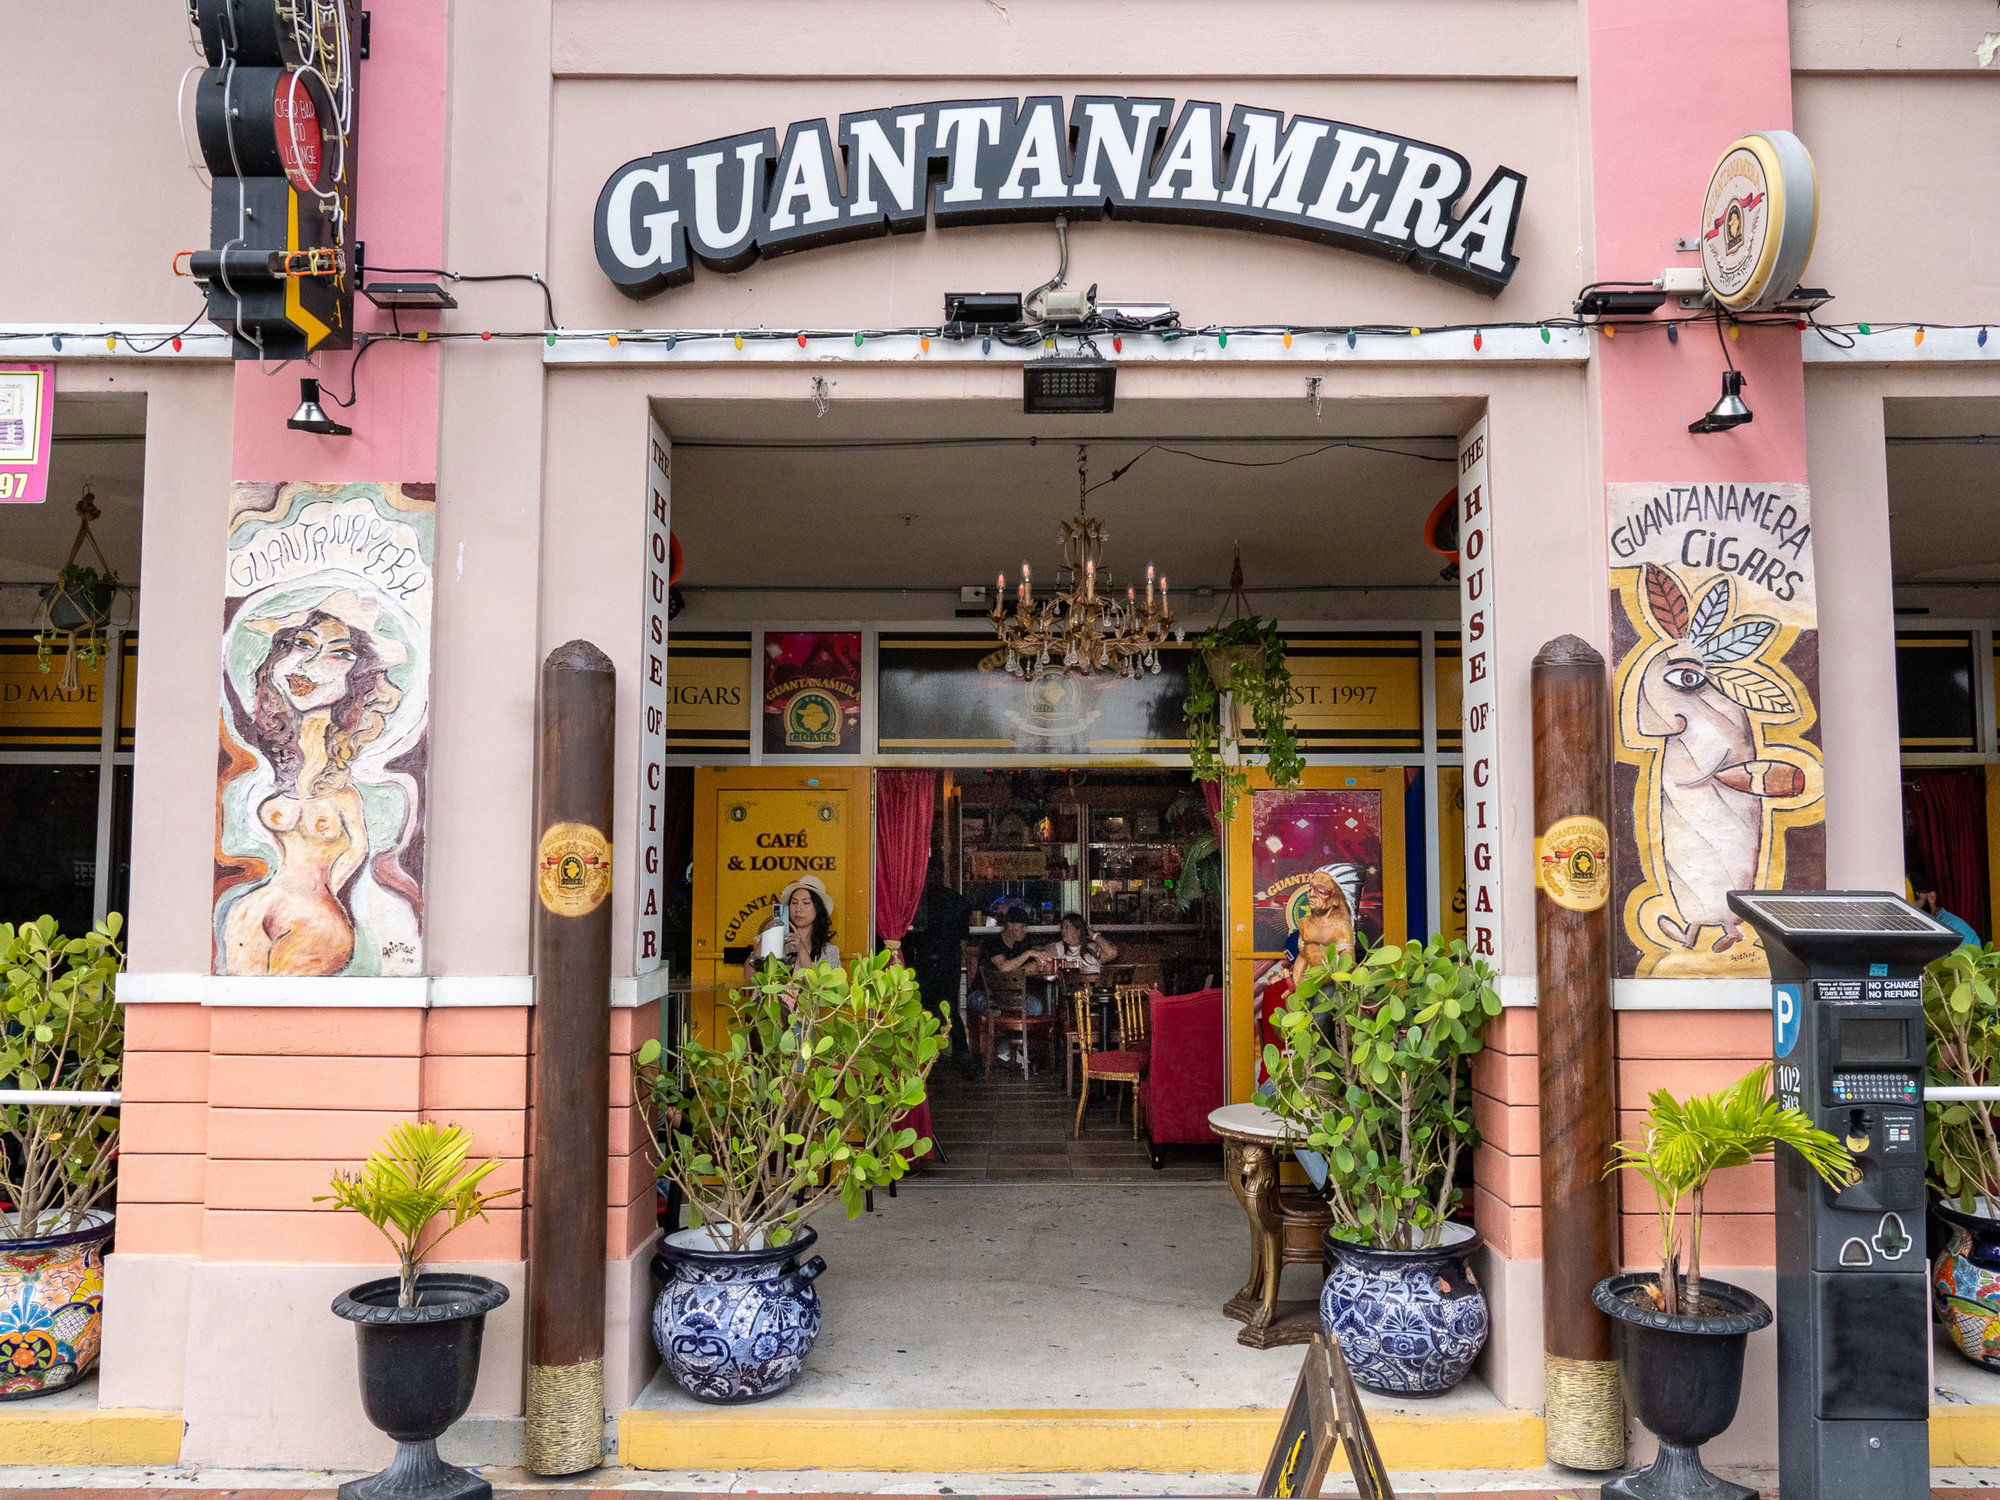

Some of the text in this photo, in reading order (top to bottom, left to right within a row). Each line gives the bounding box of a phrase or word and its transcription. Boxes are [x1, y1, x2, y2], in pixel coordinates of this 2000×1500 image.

[274, 98, 299, 118] CIGR
[606, 103, 1518, 273] GUANTANAMERA
[1610, 484, 1811, 561] GUANTANAMERA
[229, 514, 427, 601] GUANTANAMERA
[28, 684, 98, 703] MADE
[641, 438, 670, 959] THE HOUSE OF CIGAR
[765, 677, 861, 703] GUANTANAMERA
[1330, 686, 1378, 705] 1997
[1460, 435, 1495, 956] THE HOUSE OF CIGAR
[790, 732, 836, 743] CIGARS
[756, 829, 808, 849] CAFÉ
[727, 856, 837, 872] & LOUNGE
[1868, 981, 1920, 990] NO CHANGE
[1868, 990, 1919, 998] NO REFUND
[1777, 990, 1794, 1044] P
[1777, 1064, 1800, 1093] 102
[1782, 1094, 1800, 1110] 503
